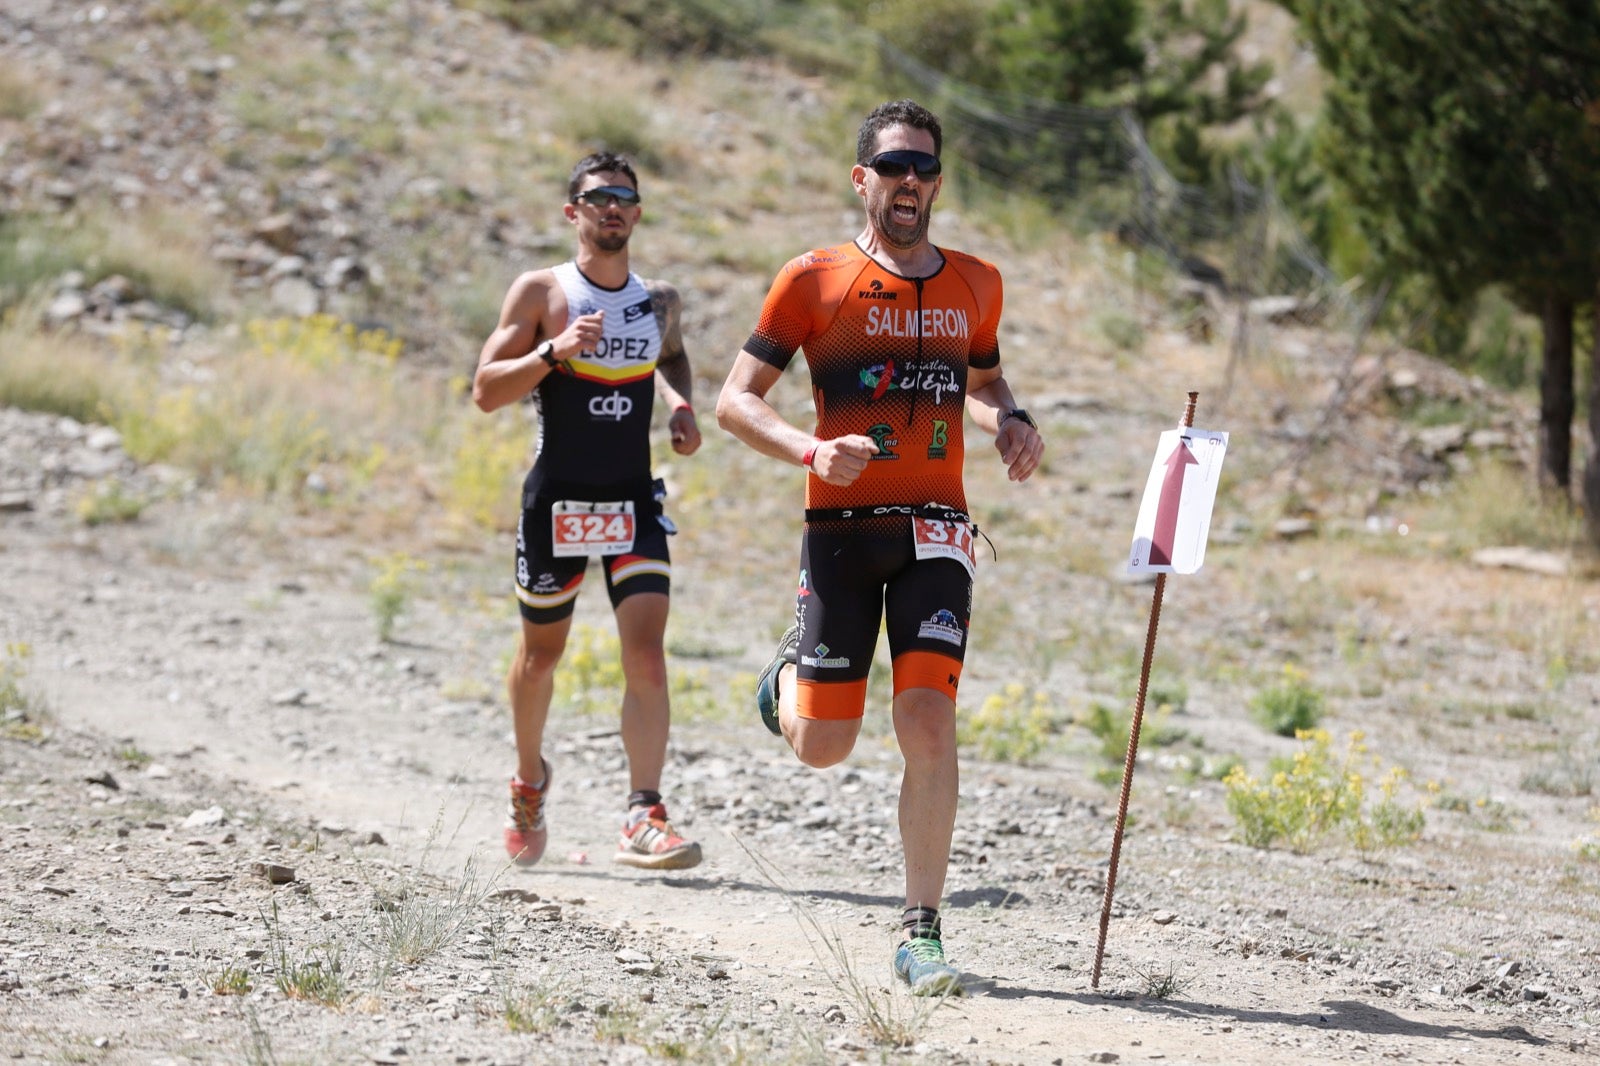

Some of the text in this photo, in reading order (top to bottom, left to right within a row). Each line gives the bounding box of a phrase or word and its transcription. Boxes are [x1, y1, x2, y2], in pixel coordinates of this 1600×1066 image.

[859, 291, 897, 300] VIATOR
[865, 306, 968, 339] SALMERON
[588, 390, 633, 421] cdp
[562, 515, 628, 542] 324
